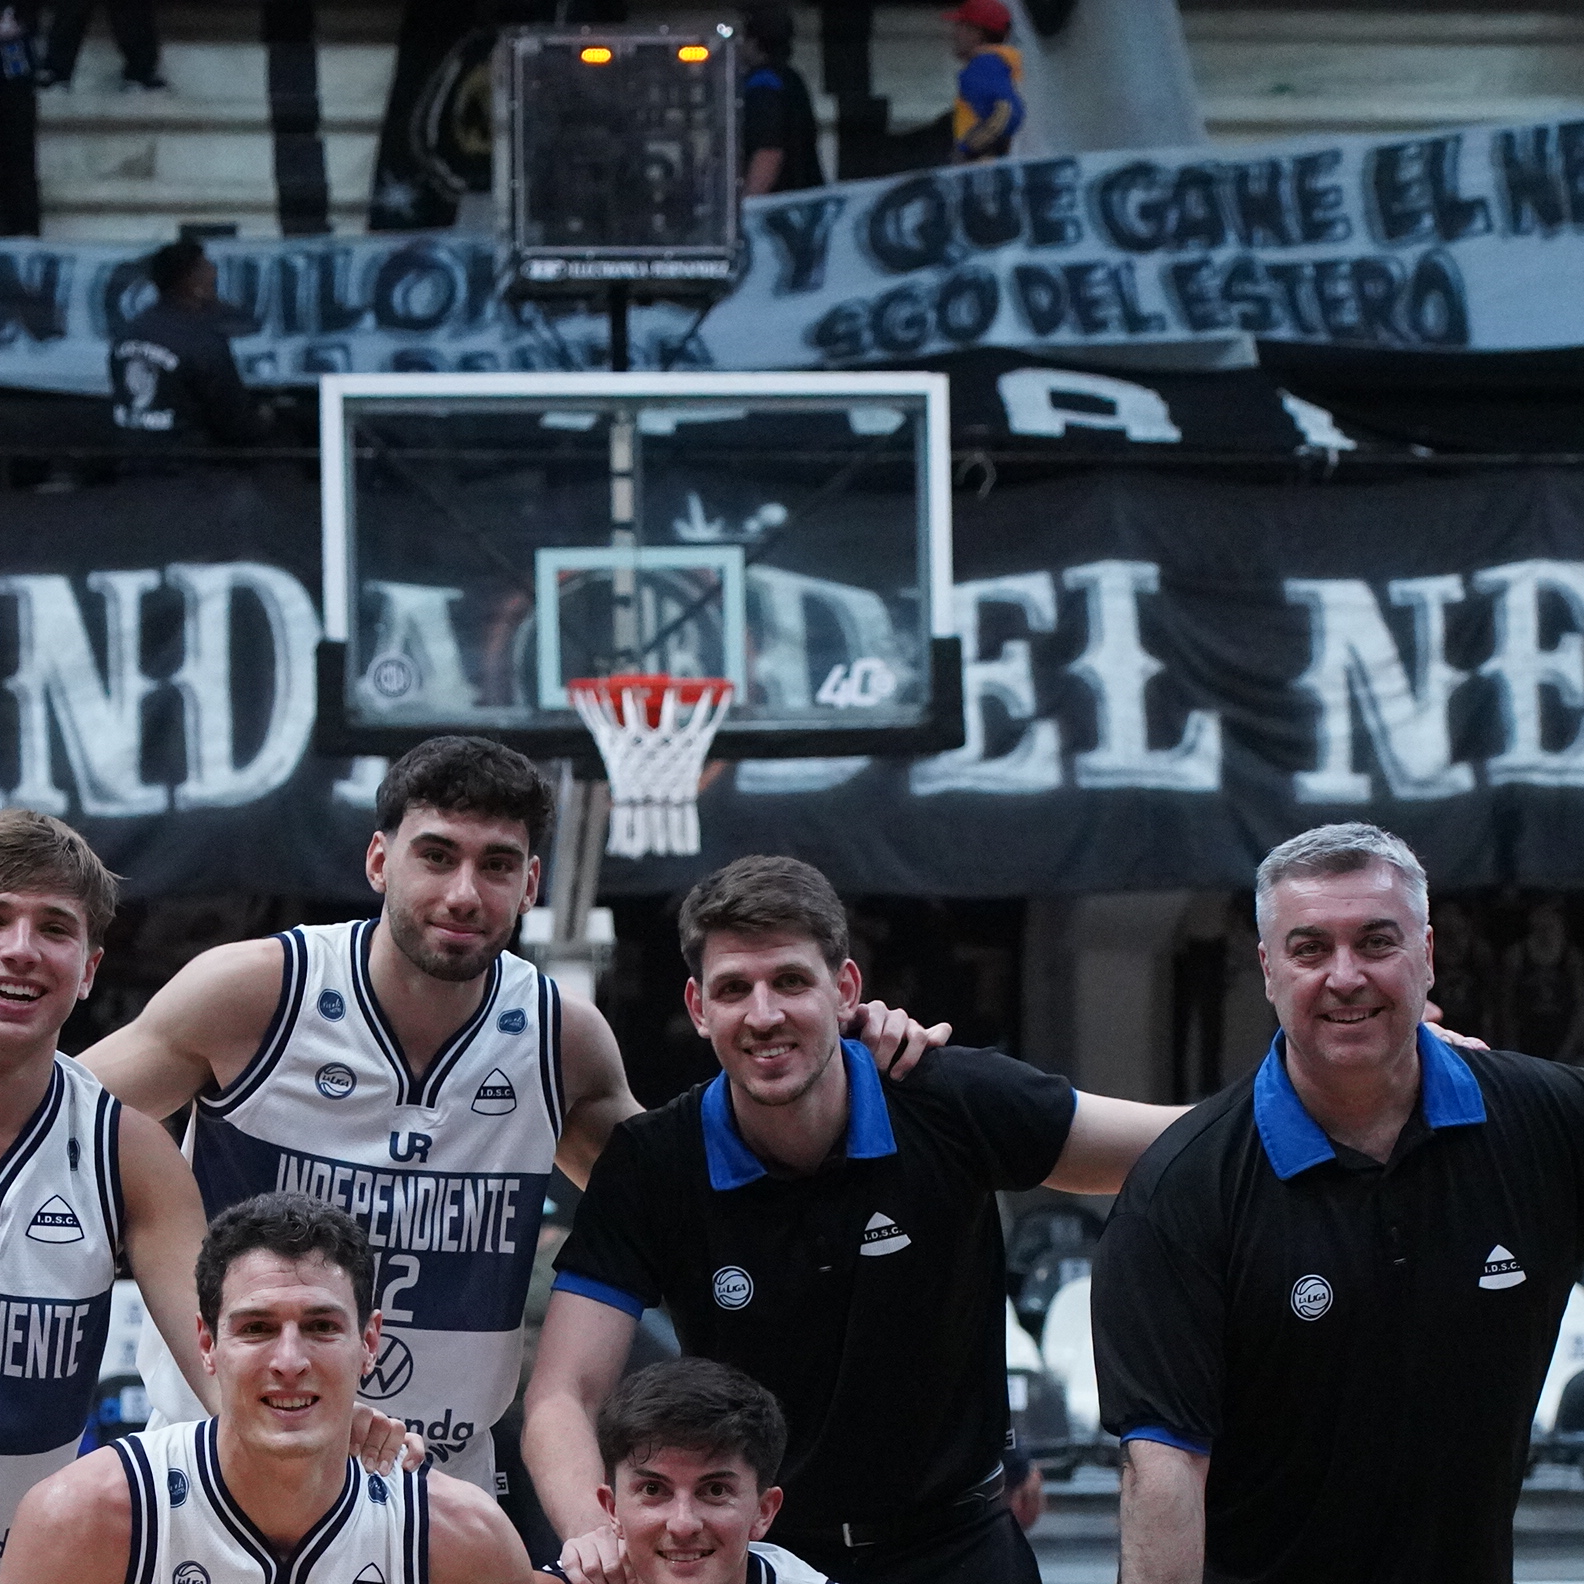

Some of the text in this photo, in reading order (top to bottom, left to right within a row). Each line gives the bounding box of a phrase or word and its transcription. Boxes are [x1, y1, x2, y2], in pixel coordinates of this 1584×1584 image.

[762, 197, 844, 296] Y
[854, 155, 1081, 274] QUE
[1089, 147, 1351, 255] GANE
[1362, 132, 1492, 249] EL
[804, 248, 1470, 364] SGO DEL ESTERO
[388, 1131, 433, 1164] UR
[36, 1215, 78, 1226] I.D.S.C.
[863, 1226, 903, 1241] I.D.S.C.
[1484, 1261, 1521, 1274] I.D.S.C.
[373, 1252, 420, 1323] 2
